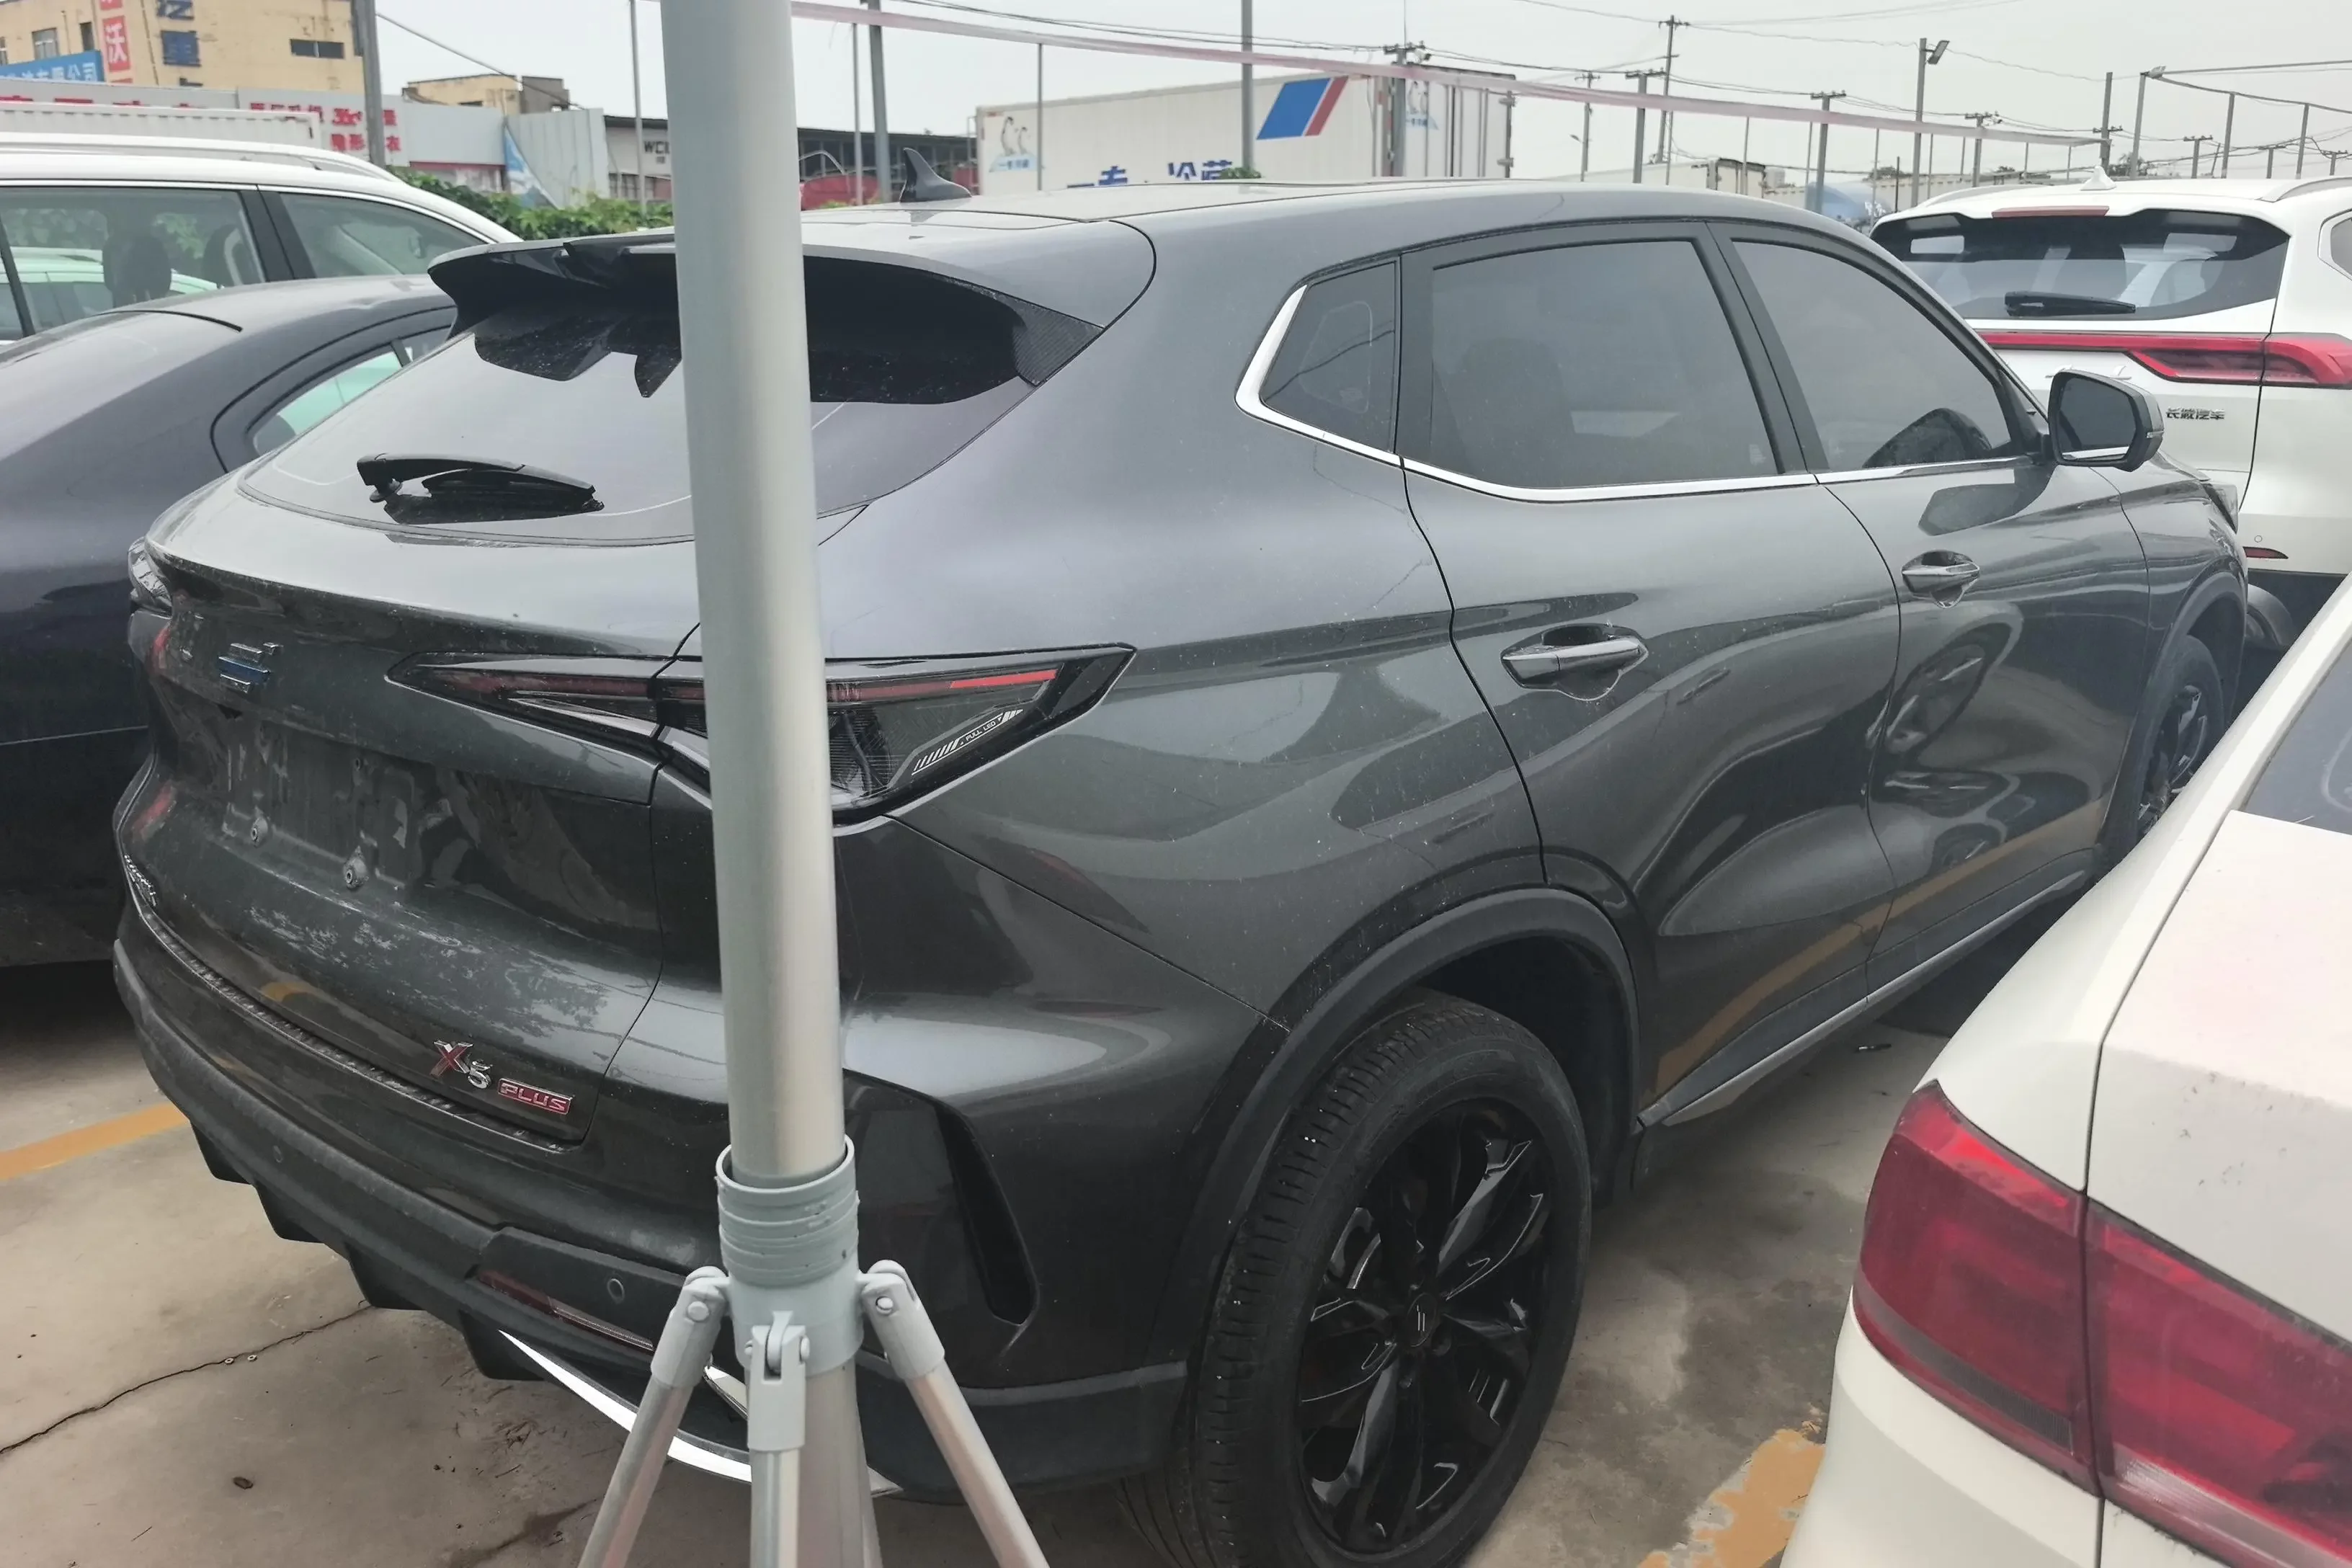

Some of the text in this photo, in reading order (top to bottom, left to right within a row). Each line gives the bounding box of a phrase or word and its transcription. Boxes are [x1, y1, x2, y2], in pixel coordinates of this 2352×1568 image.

[966, 721, 996, 741] FULL LED
[500, 1082, 567, 1112] PLUS
